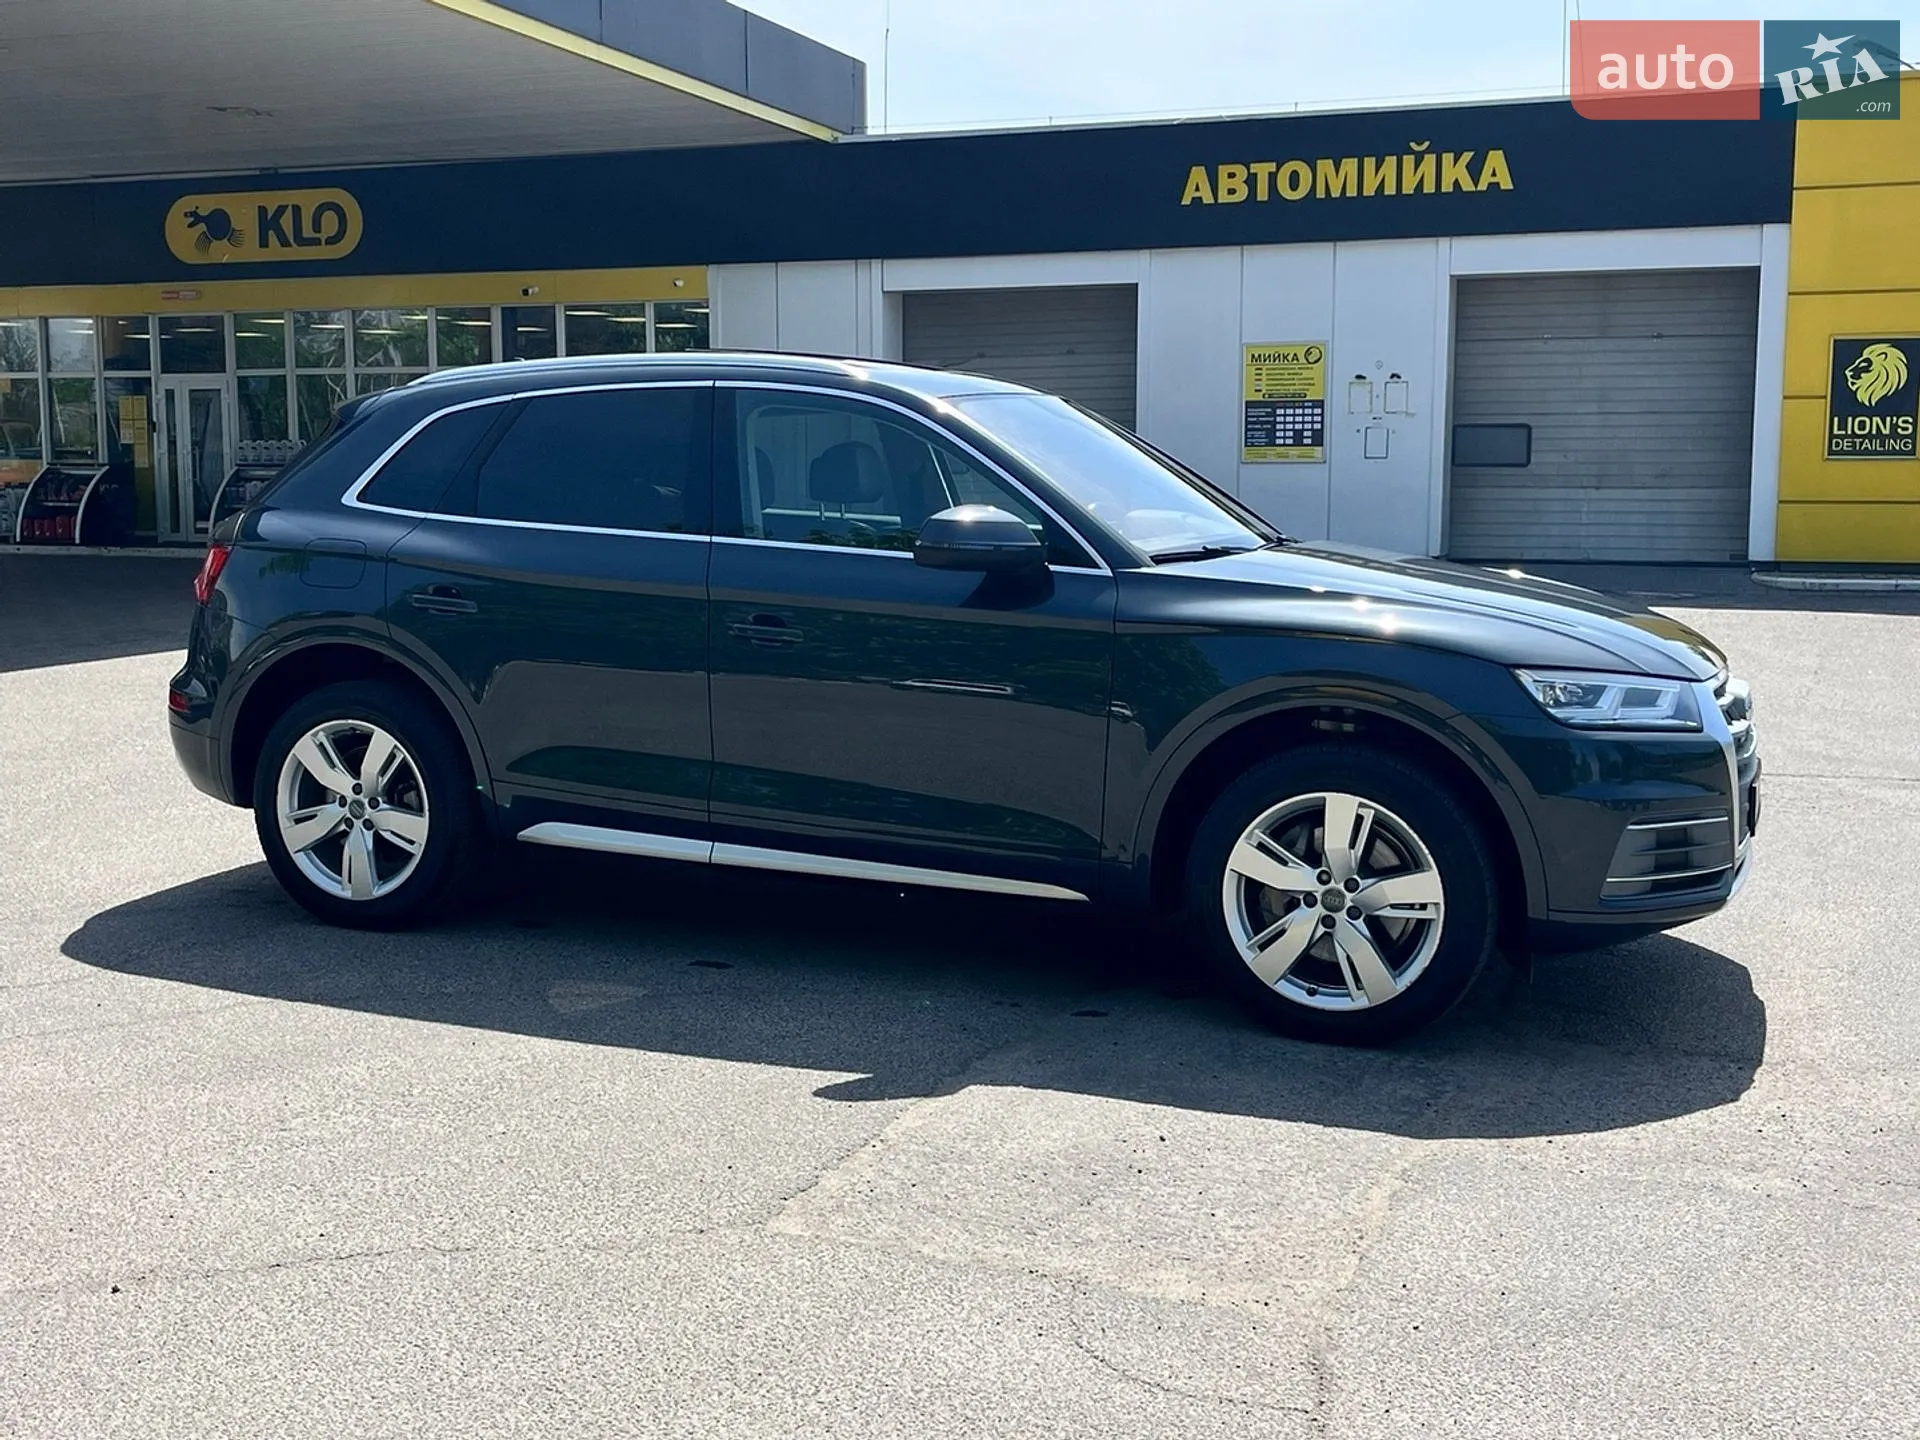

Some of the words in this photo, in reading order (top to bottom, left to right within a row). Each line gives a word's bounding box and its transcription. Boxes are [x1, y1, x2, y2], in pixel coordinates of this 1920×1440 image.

[1180, 140, 1514, 206] АВТОМИЙКА
[257, 201, 348, 249] KLO
[1250, 350, 1300, 363] МИЙКА
[1833, 415, 1914, 435] LION'S
[1831, 438, 1913, 451] DETAILING
